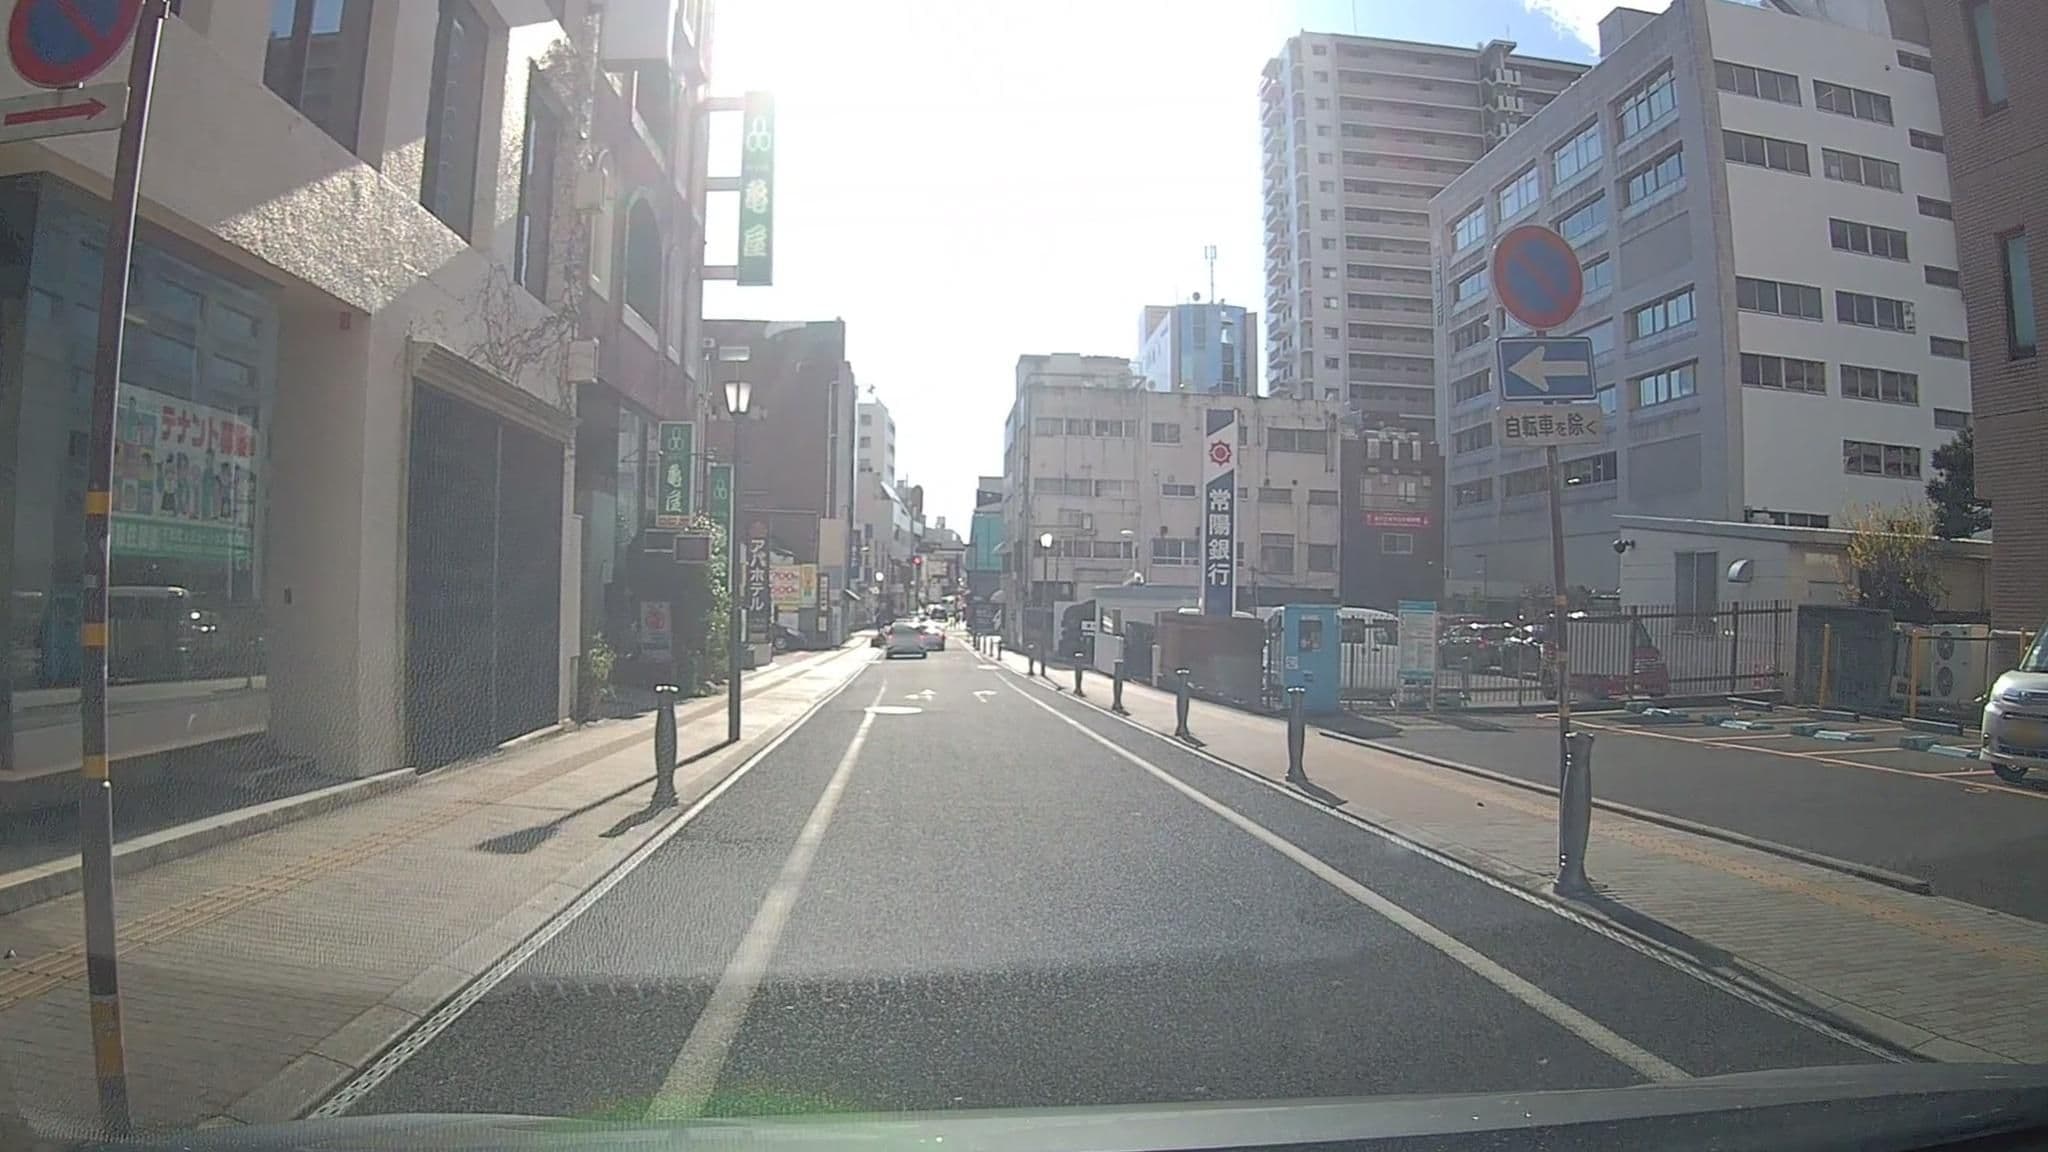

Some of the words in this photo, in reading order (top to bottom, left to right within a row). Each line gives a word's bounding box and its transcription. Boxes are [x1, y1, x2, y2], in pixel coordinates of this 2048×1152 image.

[1506, 413, 1597, 438] 自転車を除く
[1208, 489, 1231, 585] 常陽銀行
[750, 539, 766, 611] アパホテル
